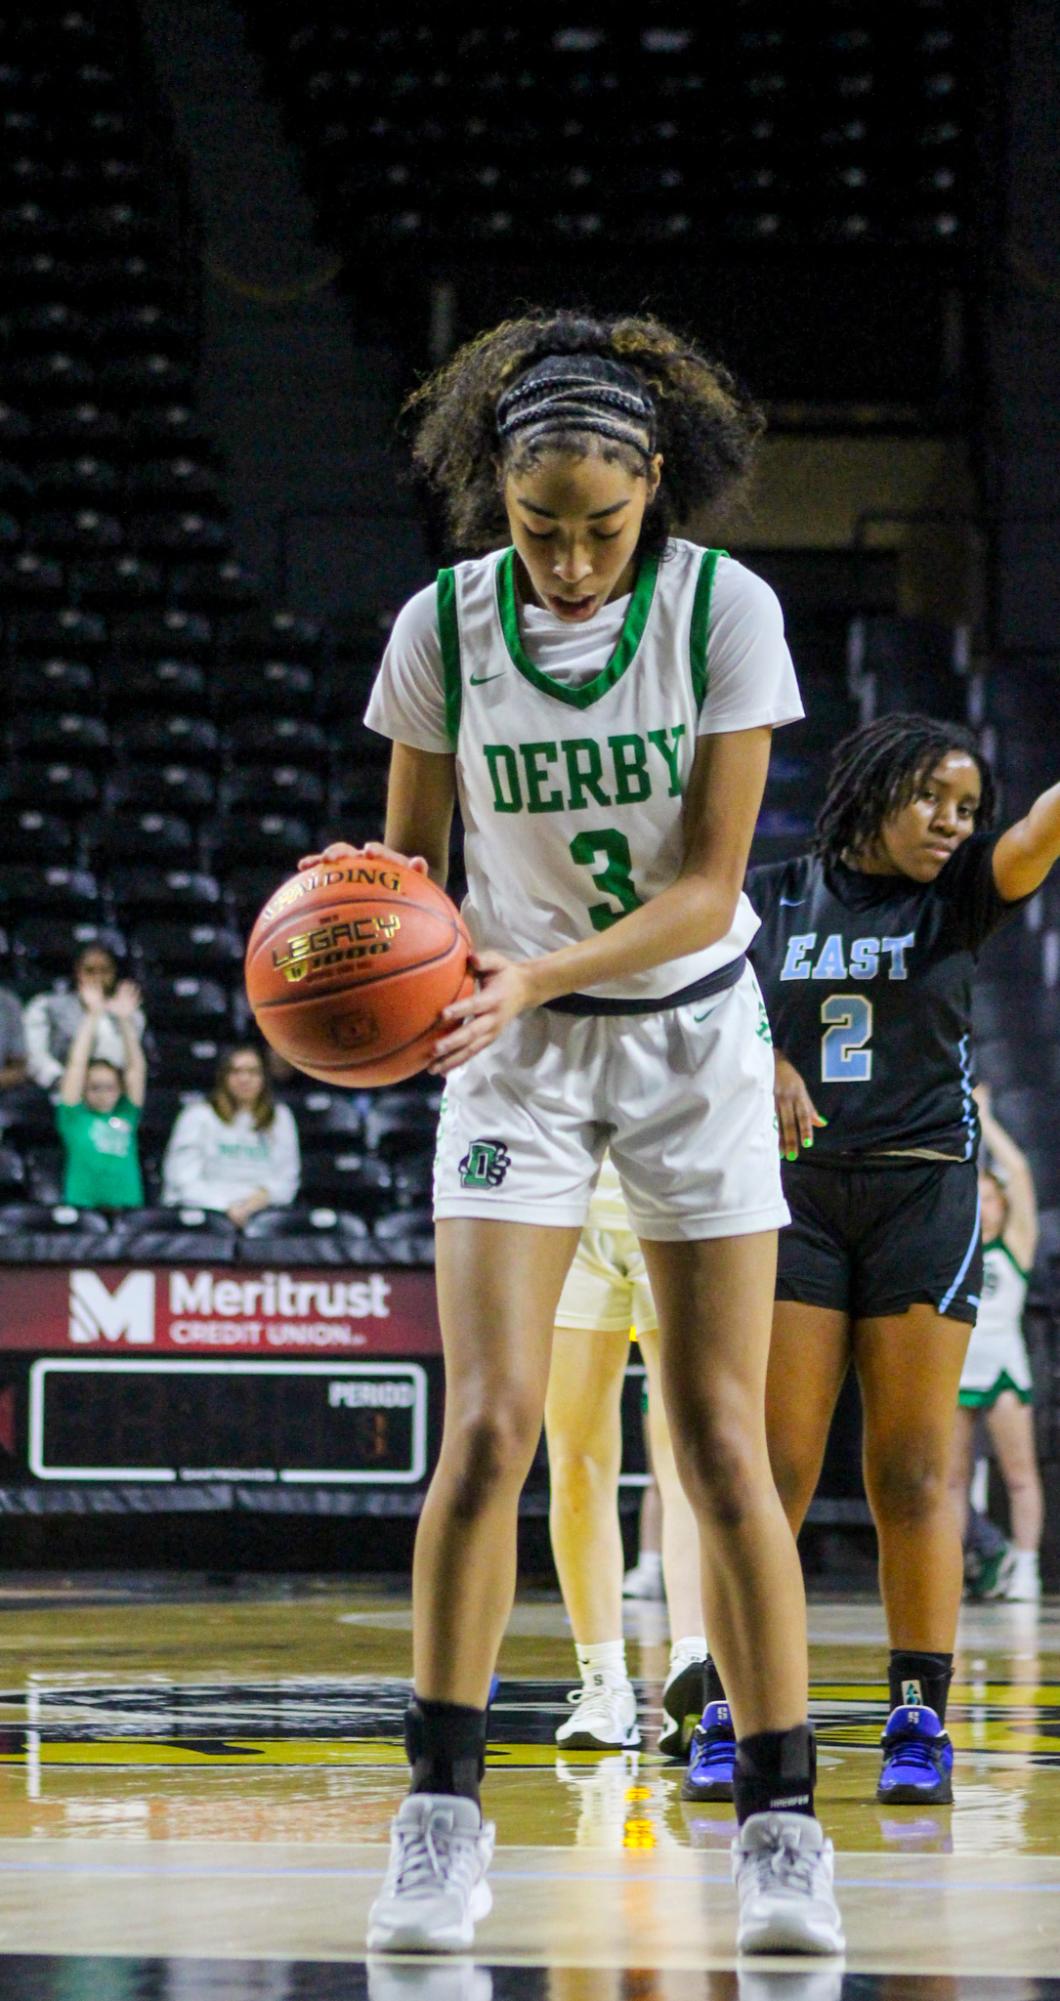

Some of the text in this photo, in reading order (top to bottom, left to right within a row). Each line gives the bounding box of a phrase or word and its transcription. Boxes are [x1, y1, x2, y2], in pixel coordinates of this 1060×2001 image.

[483, 724, 686, 814] DERBY
[569, 828, 644, 933] 3
[272, 914, 401, 968] LEGACY
[780, 932, 915, 981] EAST
[821, 994, 873, 1083] 2
[169, 1270, 392, 1318] Meritrust
[168, 1321, 352, 1346] CREDIT UNION
[328, 1381, 415, 1407] PERIOD
